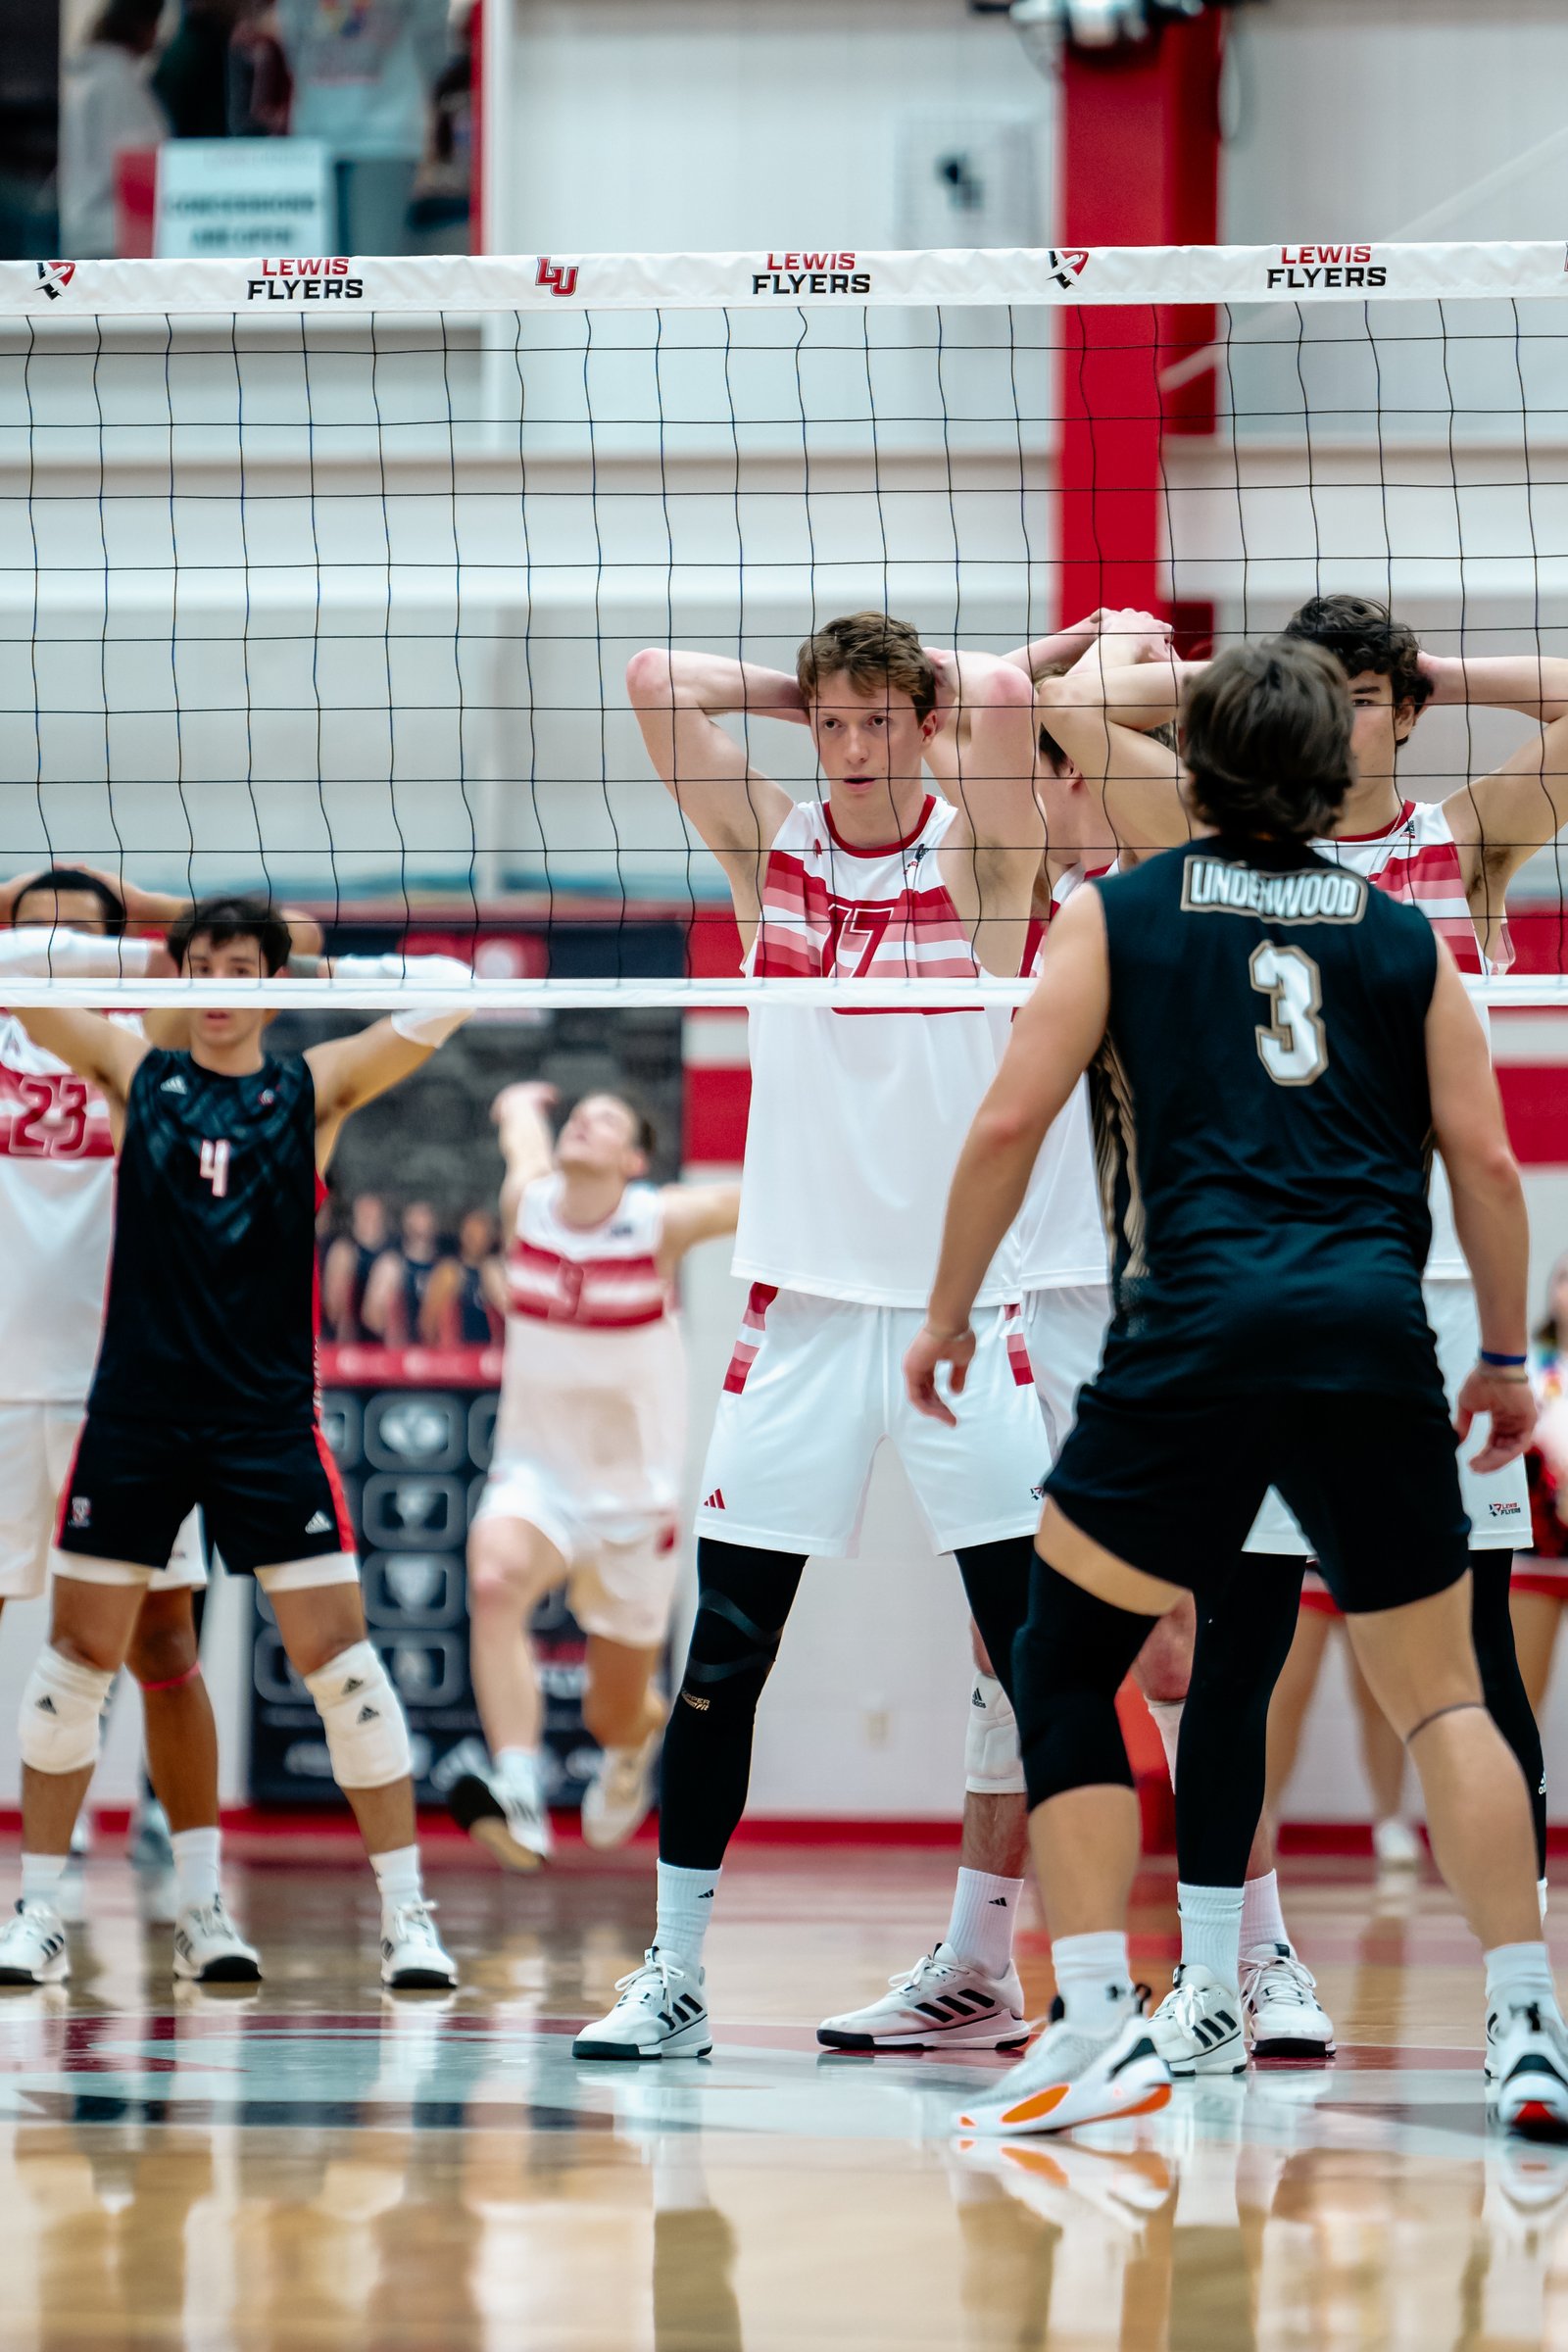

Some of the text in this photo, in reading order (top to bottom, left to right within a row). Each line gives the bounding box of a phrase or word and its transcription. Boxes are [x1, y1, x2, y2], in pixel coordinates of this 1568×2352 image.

[766, 253, 856, 270] LEWIS
[1281, 246, 1371, 265] LEWIS
[262, 258, 350, 275] LEWIS
[535, 257, 579, 297] LU
[752, 273, 871, 294] FLYERS
[1266, 267, 1387, 288] FLYERS
[247, 279, 364, 300] FLYERS
[1250, 940, 1329, 1086] 3
[8, 1076, 88, 1157] 23
[199, 1138, 230, 1198] 4
